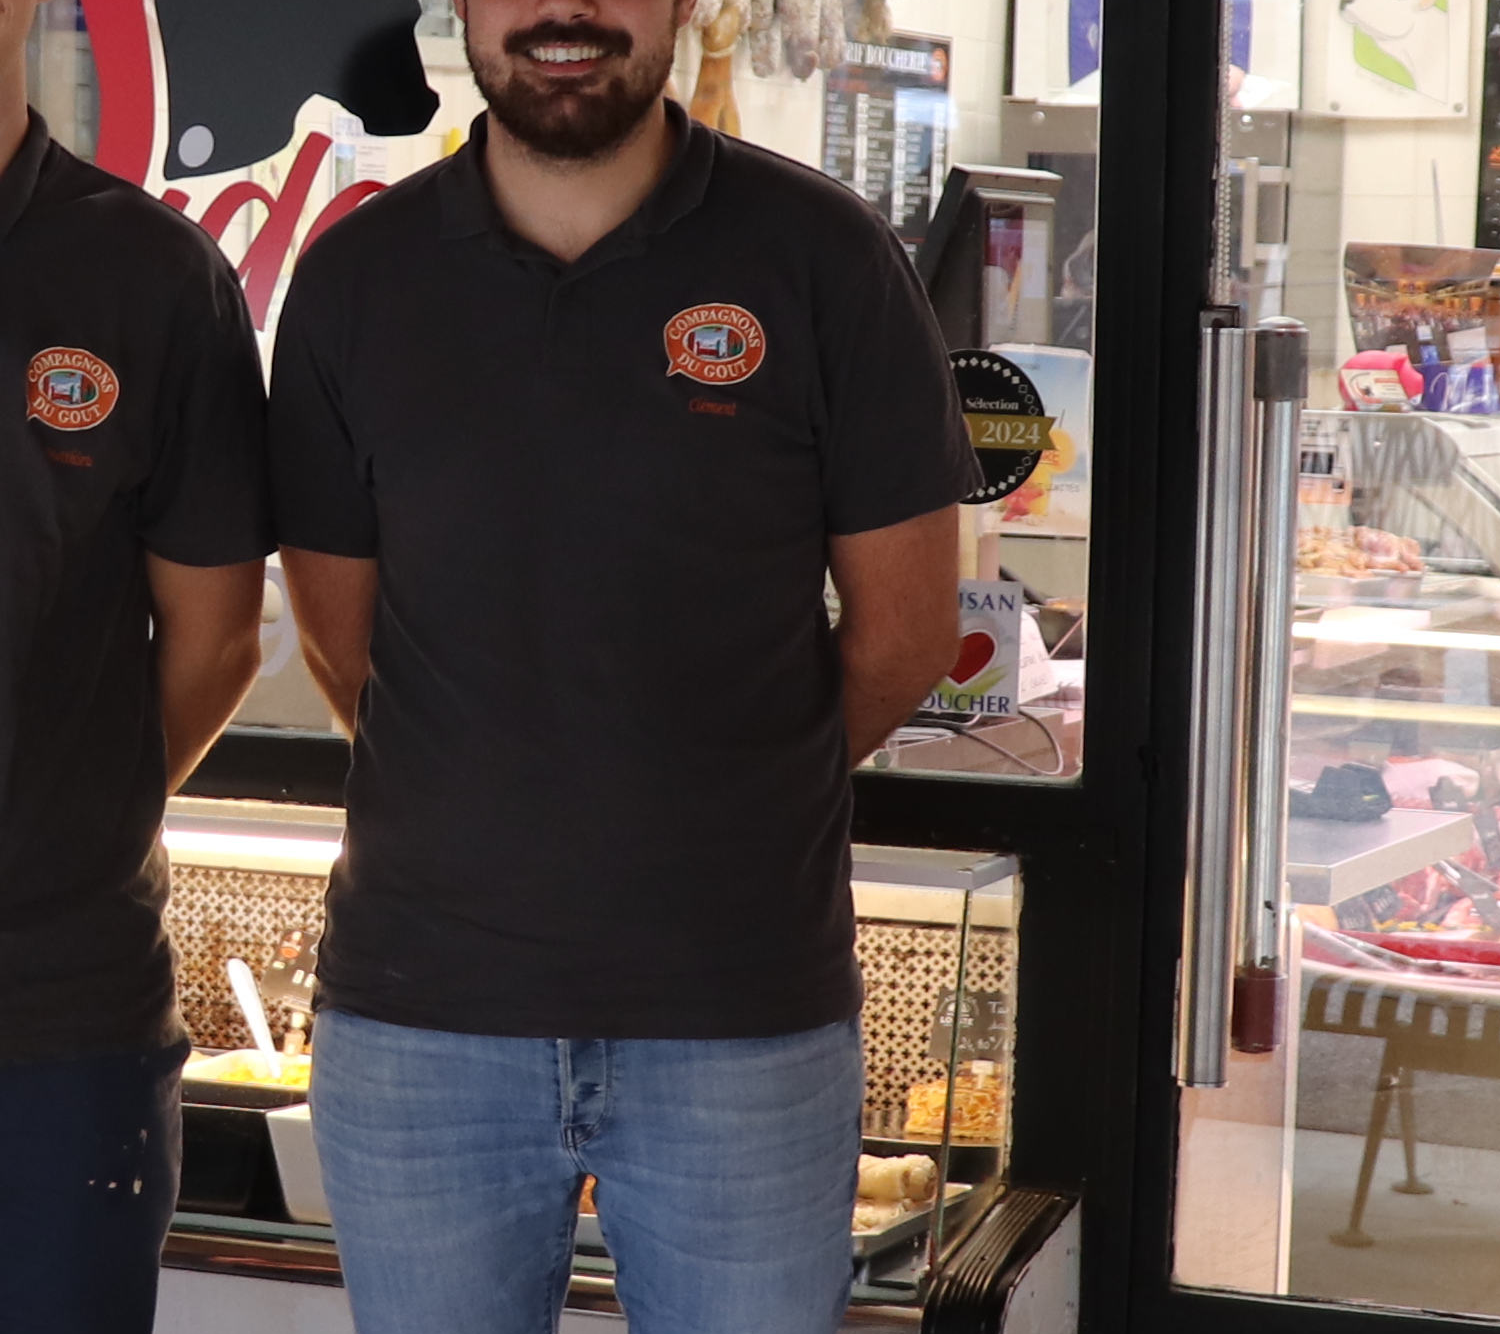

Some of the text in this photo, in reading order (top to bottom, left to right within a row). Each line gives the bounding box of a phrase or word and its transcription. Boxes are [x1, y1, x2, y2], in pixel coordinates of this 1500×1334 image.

[866, 44, 930, 72] BOUCHERIE
[667, 308, 761, 349] COMPAGNONS
[27, 352, 115, 394] COMPAGNONS
[676, 351, 749, 379] DU GOUT
[32, 395, 102, 425] DU GOUT
[965, 396, 1020, 411] Sélection
[979, 420, 1042, 445] 2024
